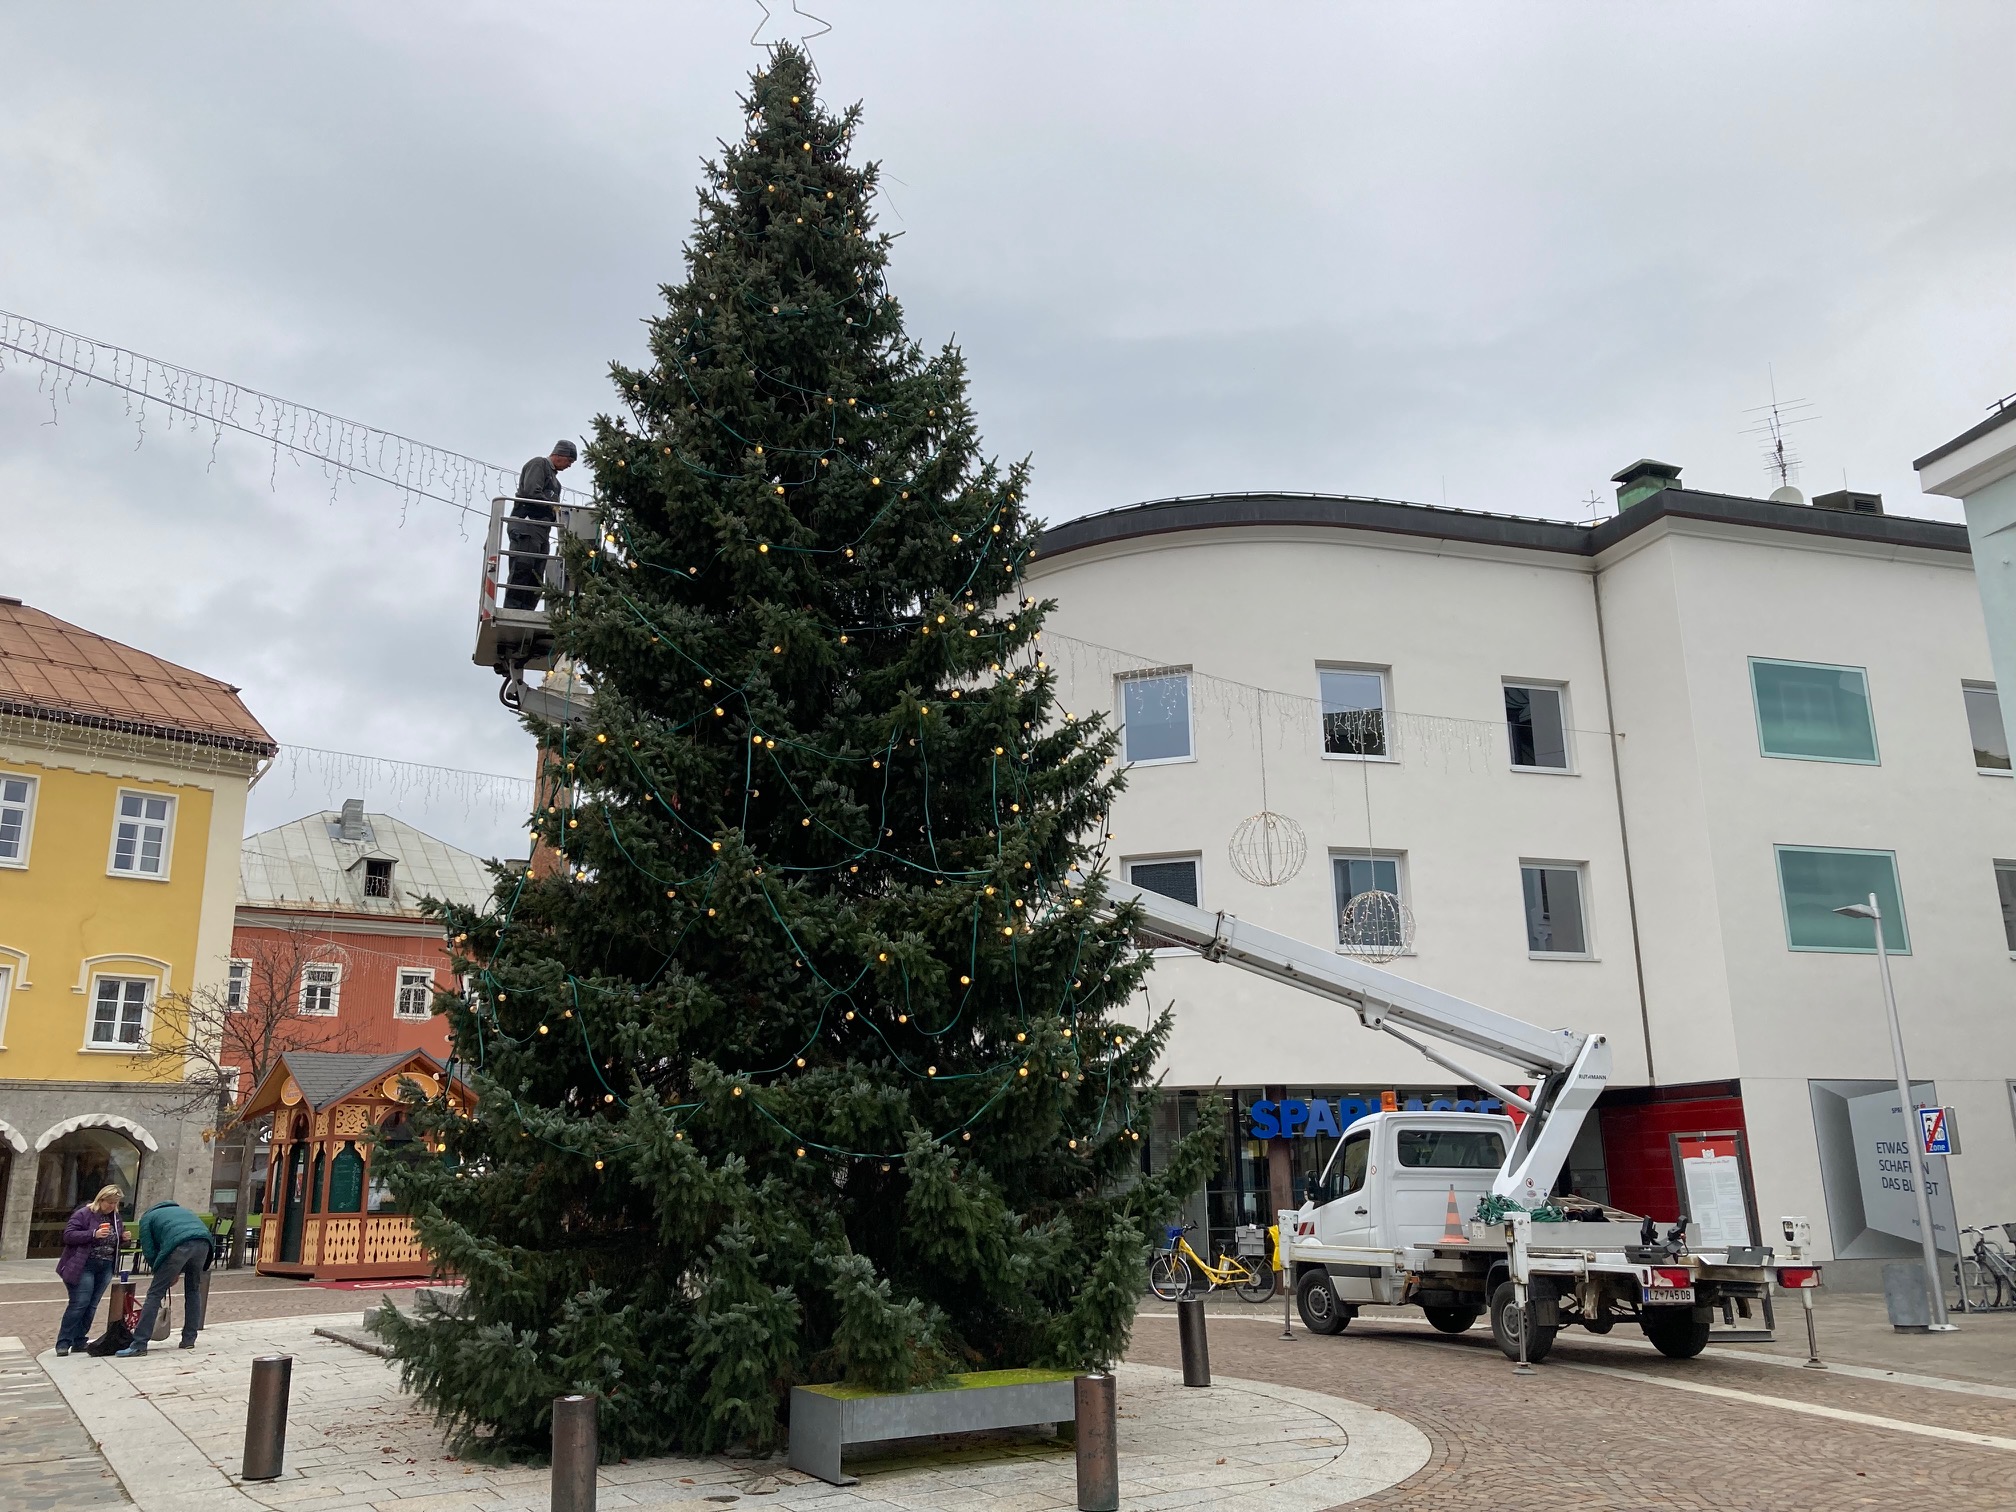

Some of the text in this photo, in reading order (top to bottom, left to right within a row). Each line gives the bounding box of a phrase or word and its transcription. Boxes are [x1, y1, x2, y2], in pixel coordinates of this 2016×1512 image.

[1876, 1141, 1909, 1154] ETWAS
[1878, 1159, 1930, 1175] SCHAFN
[1881, 1176, 1939, 1196] DAS BLBT
[1649, 1290, 1659, 1300] LZ
